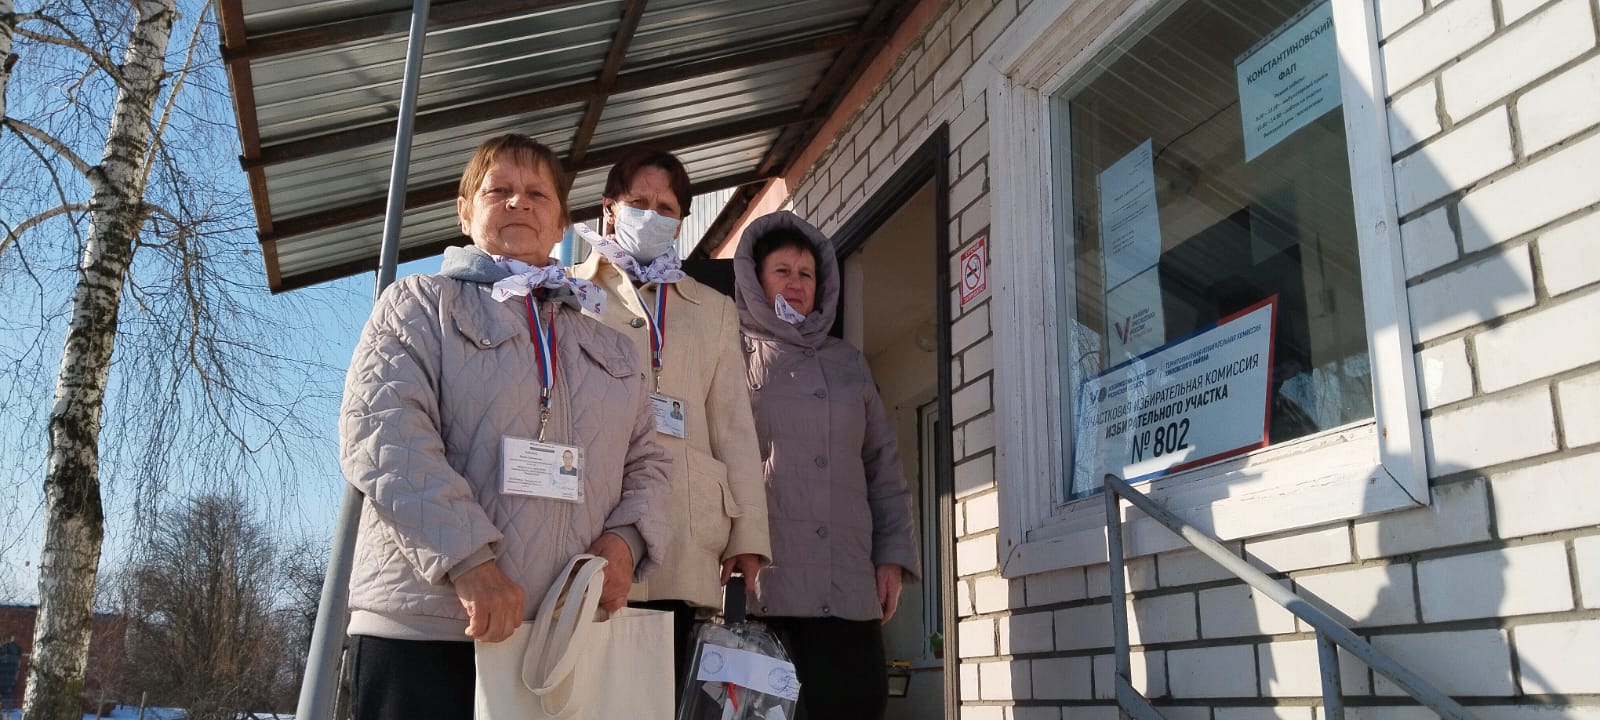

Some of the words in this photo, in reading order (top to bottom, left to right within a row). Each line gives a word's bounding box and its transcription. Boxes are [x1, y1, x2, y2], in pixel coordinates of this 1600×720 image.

[1246, 16, 1334, 85] КОНСТАНТИНОВСКИЙ
[1278, 63, 1297, 80] ФАП
[1134, 375, 1202, 412] ИЗБИРАТЕЛЬНАЯ
[1205, 353, 1259, 386] КОМИССИЯ
[1105, 400, 1183, 439] ИЗБИРАТЕЛЬНОГО
[1184, 384, 1228, 412] УЧАСТКА
[1131, 430, 1151, 464] №
[1153, 417, 1190, 458] 802
